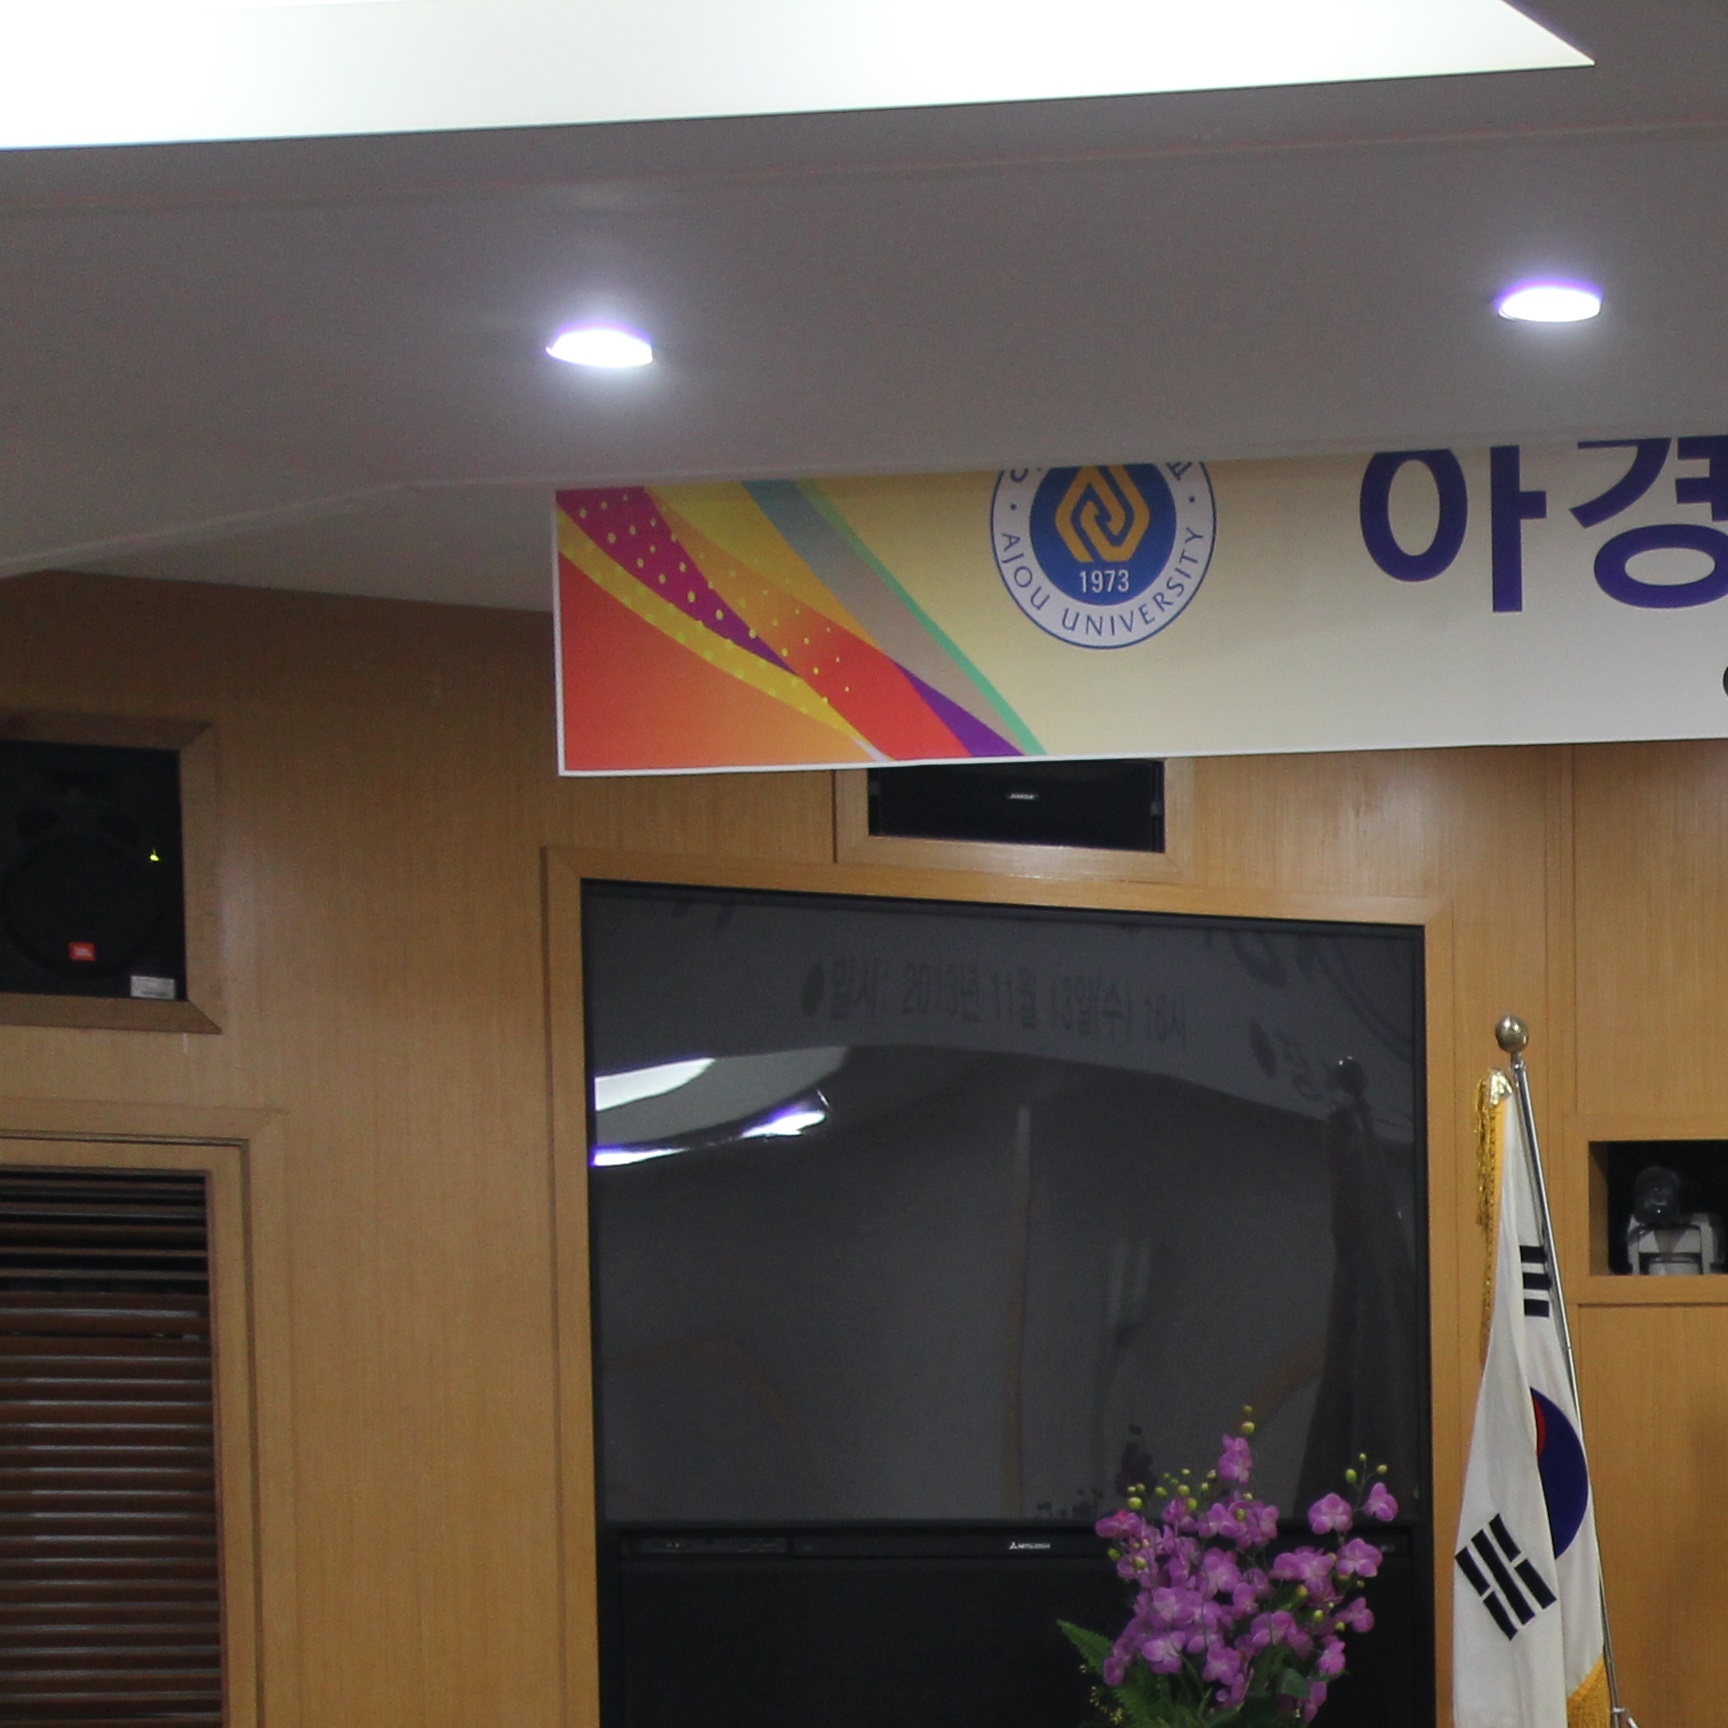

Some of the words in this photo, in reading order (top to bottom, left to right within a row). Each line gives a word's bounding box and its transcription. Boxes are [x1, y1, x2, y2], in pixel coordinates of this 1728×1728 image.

[1001, 532, 1051, 611] AJOU
[1061, 526, 1205, 637] UNIVERSITY
[1078, 568, 1130, 594] 1973
